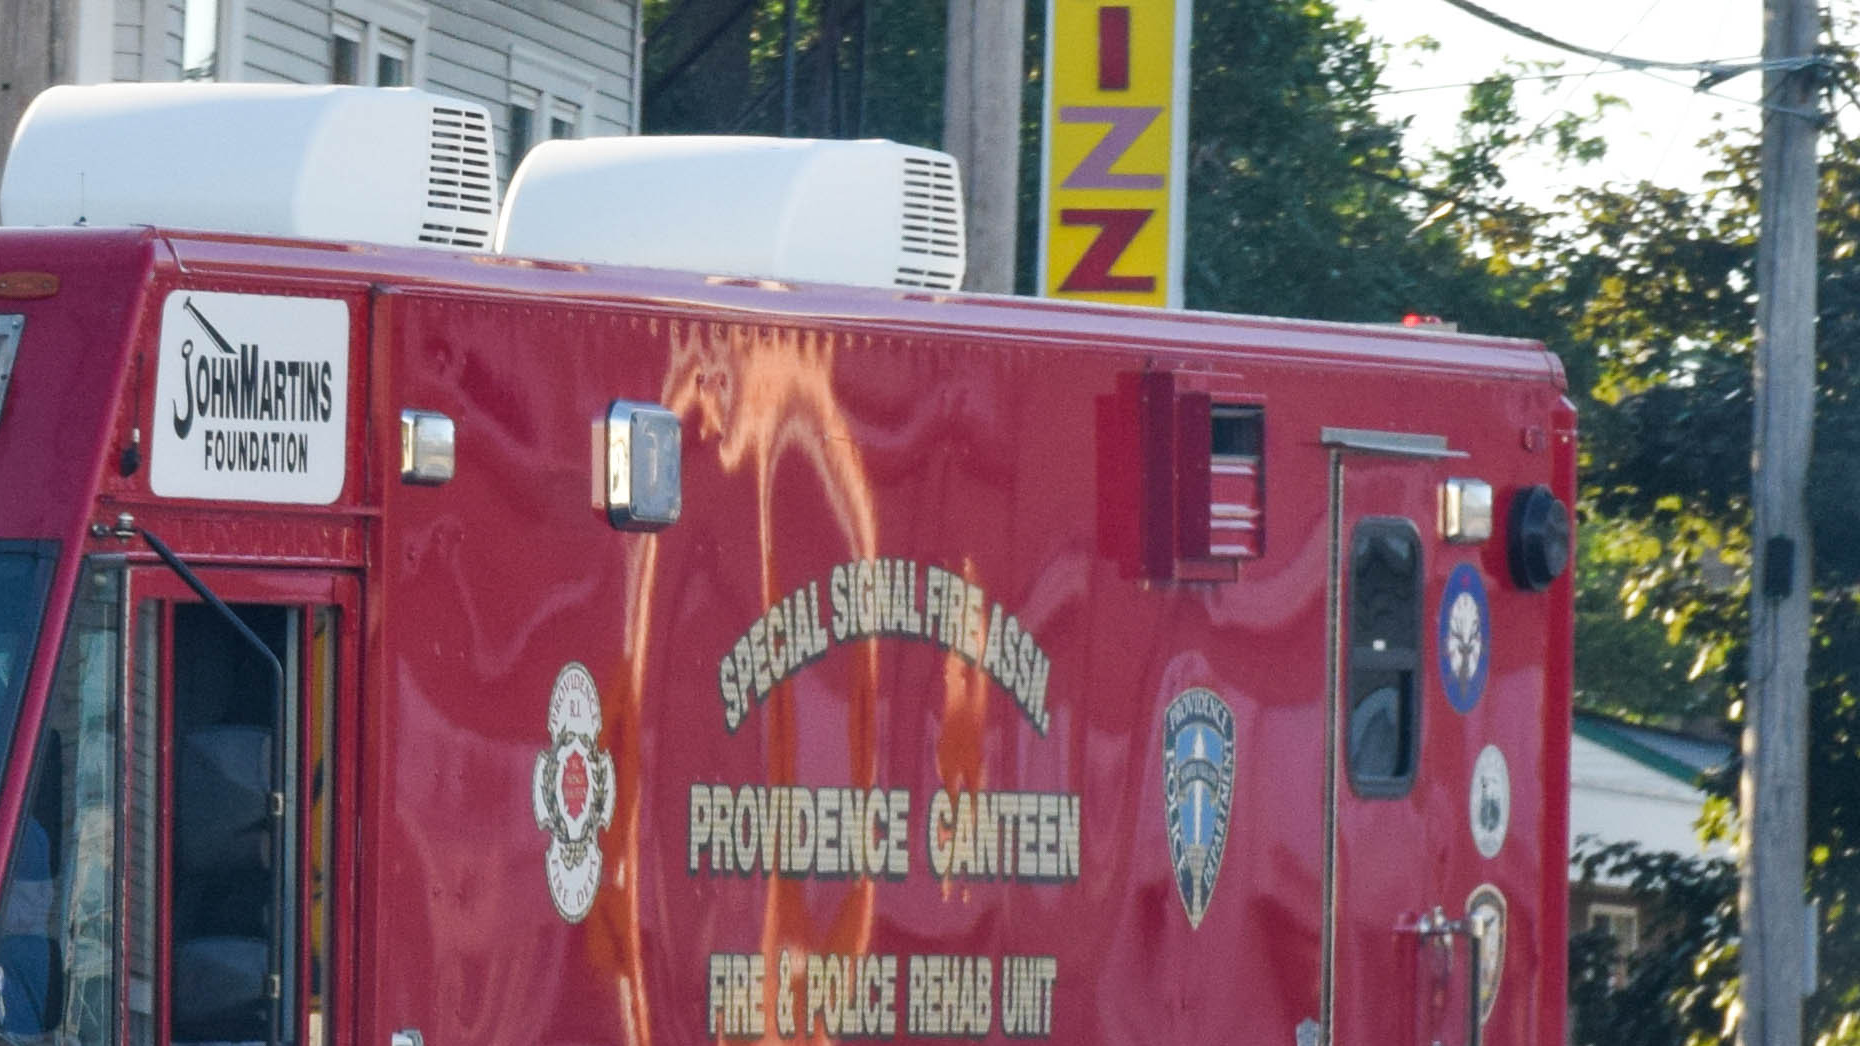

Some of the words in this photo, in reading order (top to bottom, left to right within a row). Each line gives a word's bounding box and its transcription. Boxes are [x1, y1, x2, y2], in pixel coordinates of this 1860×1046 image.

[204, 429, 309, 474] FOUNDATION
[719, 580, 829, 735] SPECIAL
[830, 558, 922, 645] SIGNAL
[924, 564, 986, 668] FIRE
[1168, 689, 1229, 733] PROVIDENCE
[688, 783, 911, 878] PROVIDENCE
[927, 788, 1082, 883] CANTEEN
[708, 952, 766, 1038] FIRE
[777, 950, 796, 1038] &
[805, 953, 898, 1038] POLICE
[907, 954, 993, 1038] REHAB
[1001, 956, 1058, 1038] UNIT
